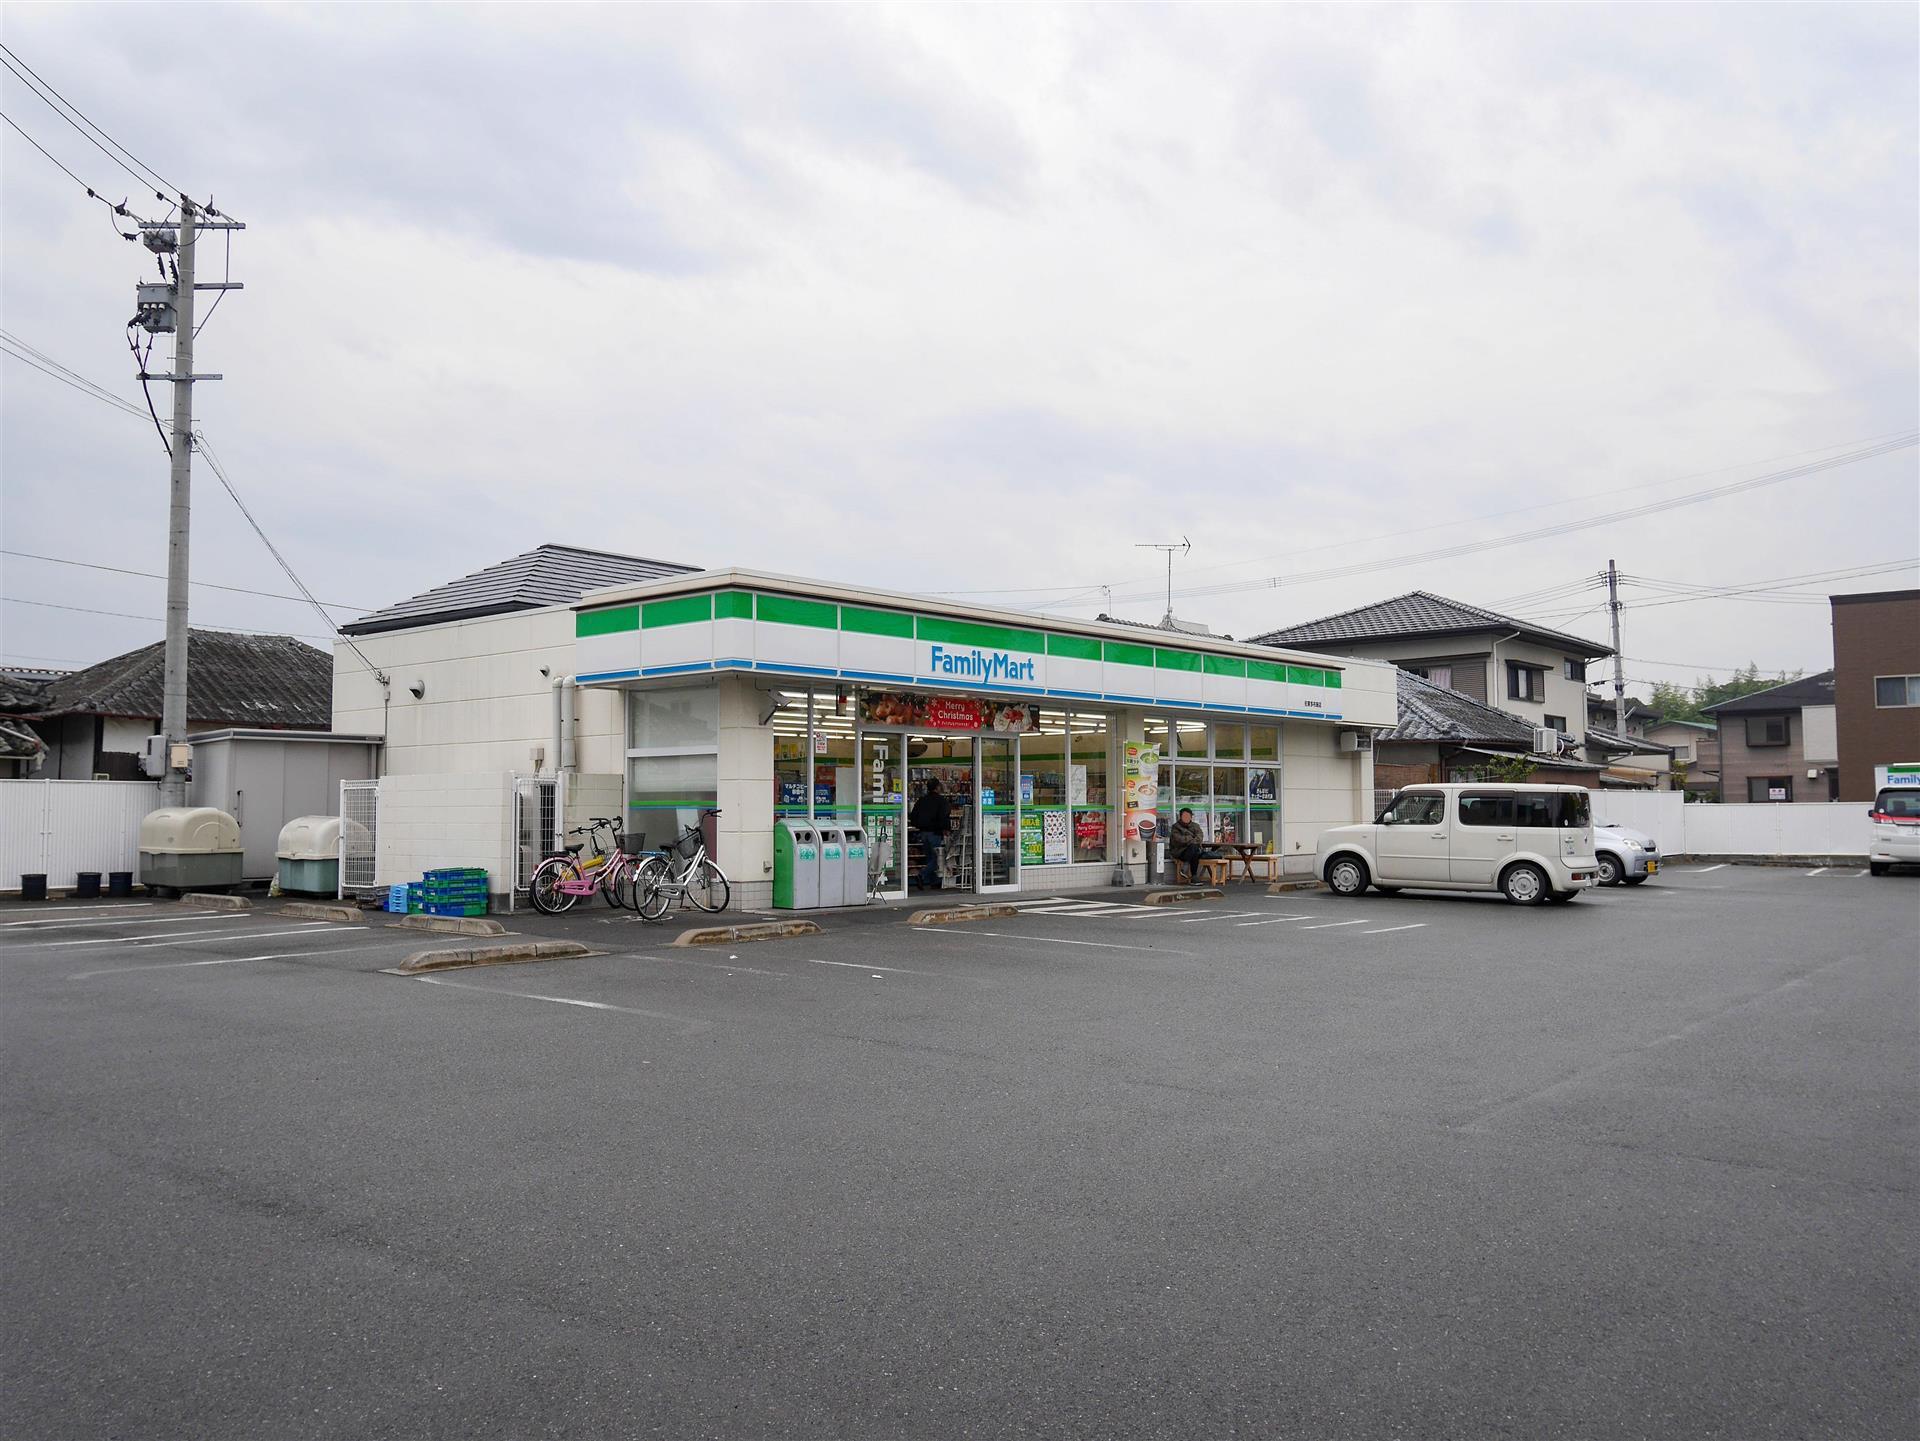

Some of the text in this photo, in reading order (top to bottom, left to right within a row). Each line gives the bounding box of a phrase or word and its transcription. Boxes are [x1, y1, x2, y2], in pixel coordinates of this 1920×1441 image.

[931, 645, 1034, 684] FamilyMart
[945, 701, 965, 712] Merry
[937, 710, 973, 721] Christmas
